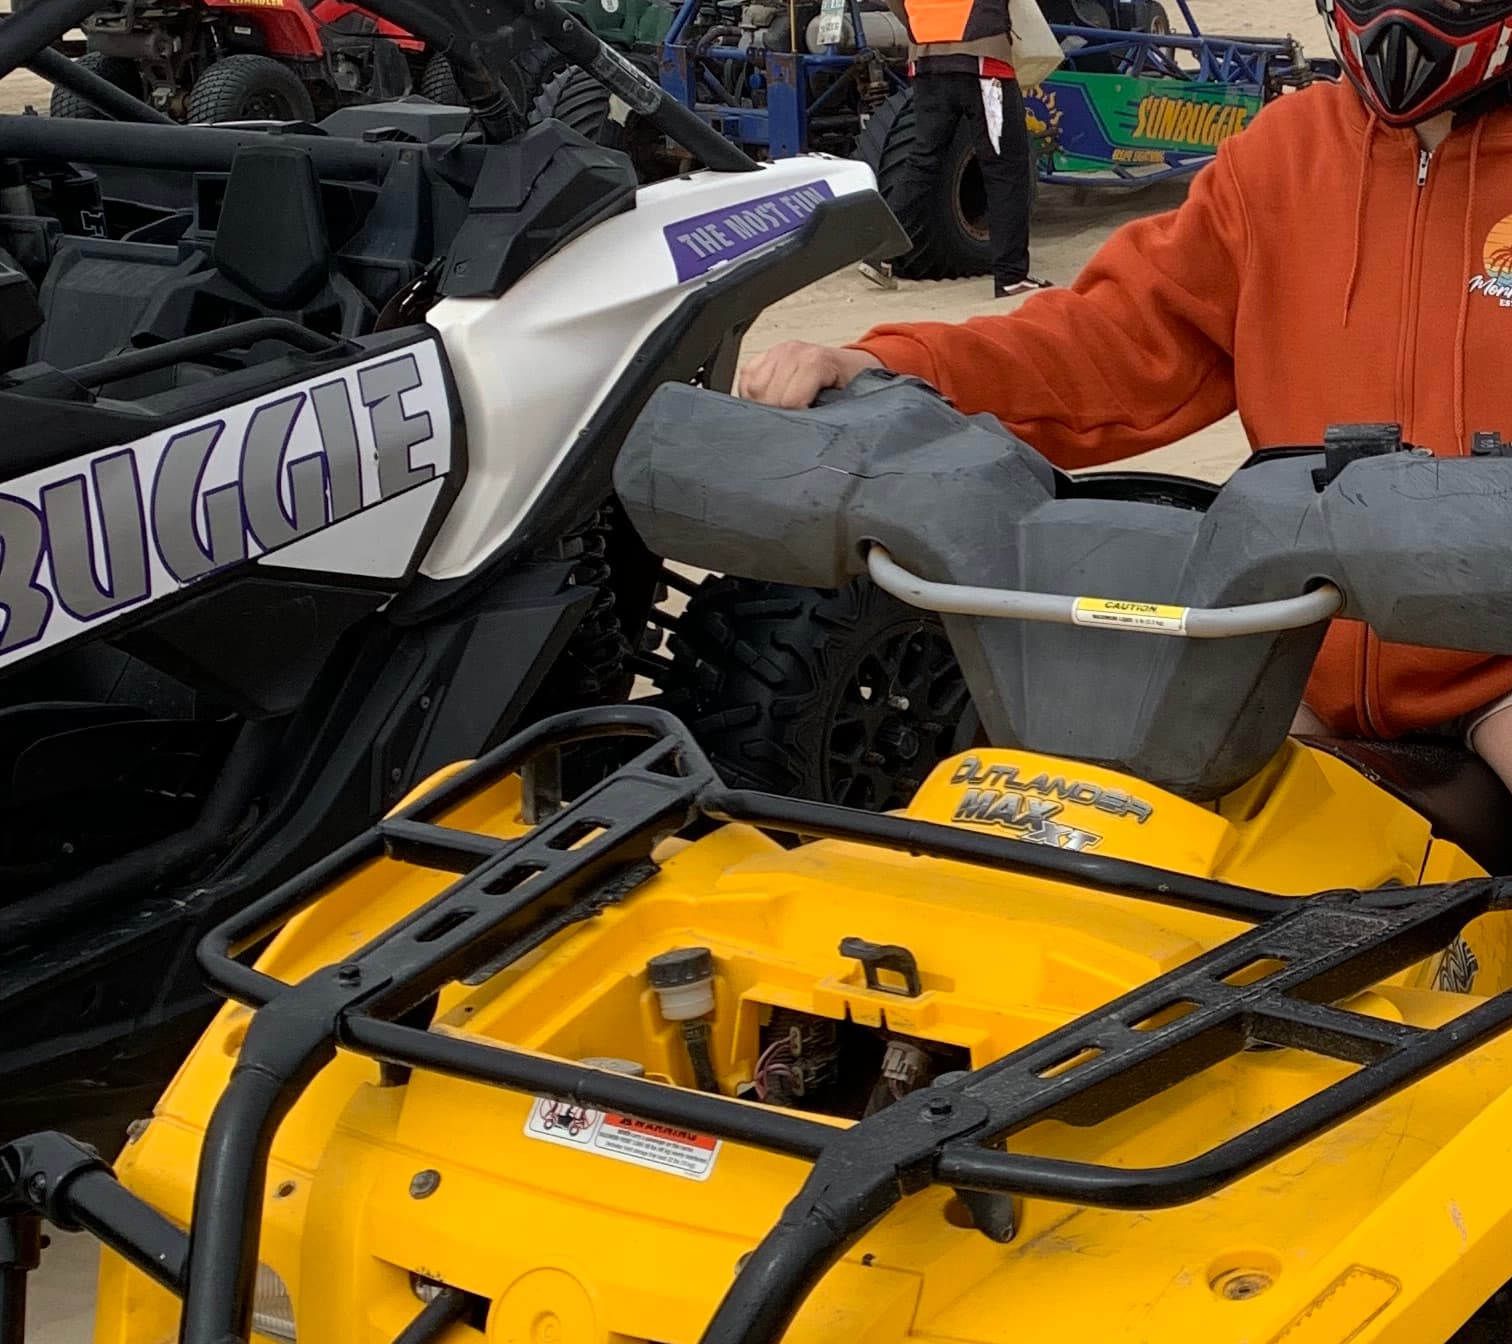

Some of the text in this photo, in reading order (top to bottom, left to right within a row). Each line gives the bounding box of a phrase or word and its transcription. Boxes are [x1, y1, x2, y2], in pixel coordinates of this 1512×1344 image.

[1133, 95, 1248, 146] SUNBUGGIE
[677, 187, 826, 258] THE MOST FUN
[1104, 601, 1158, 612] CAUTION
[950, 757, 1154, 824] OUTLANDER
[951, 788, 1064, 832] MAX
[1020, 820, 1104, 852] XT
[635, 1120, 697, 1141] WARNING
